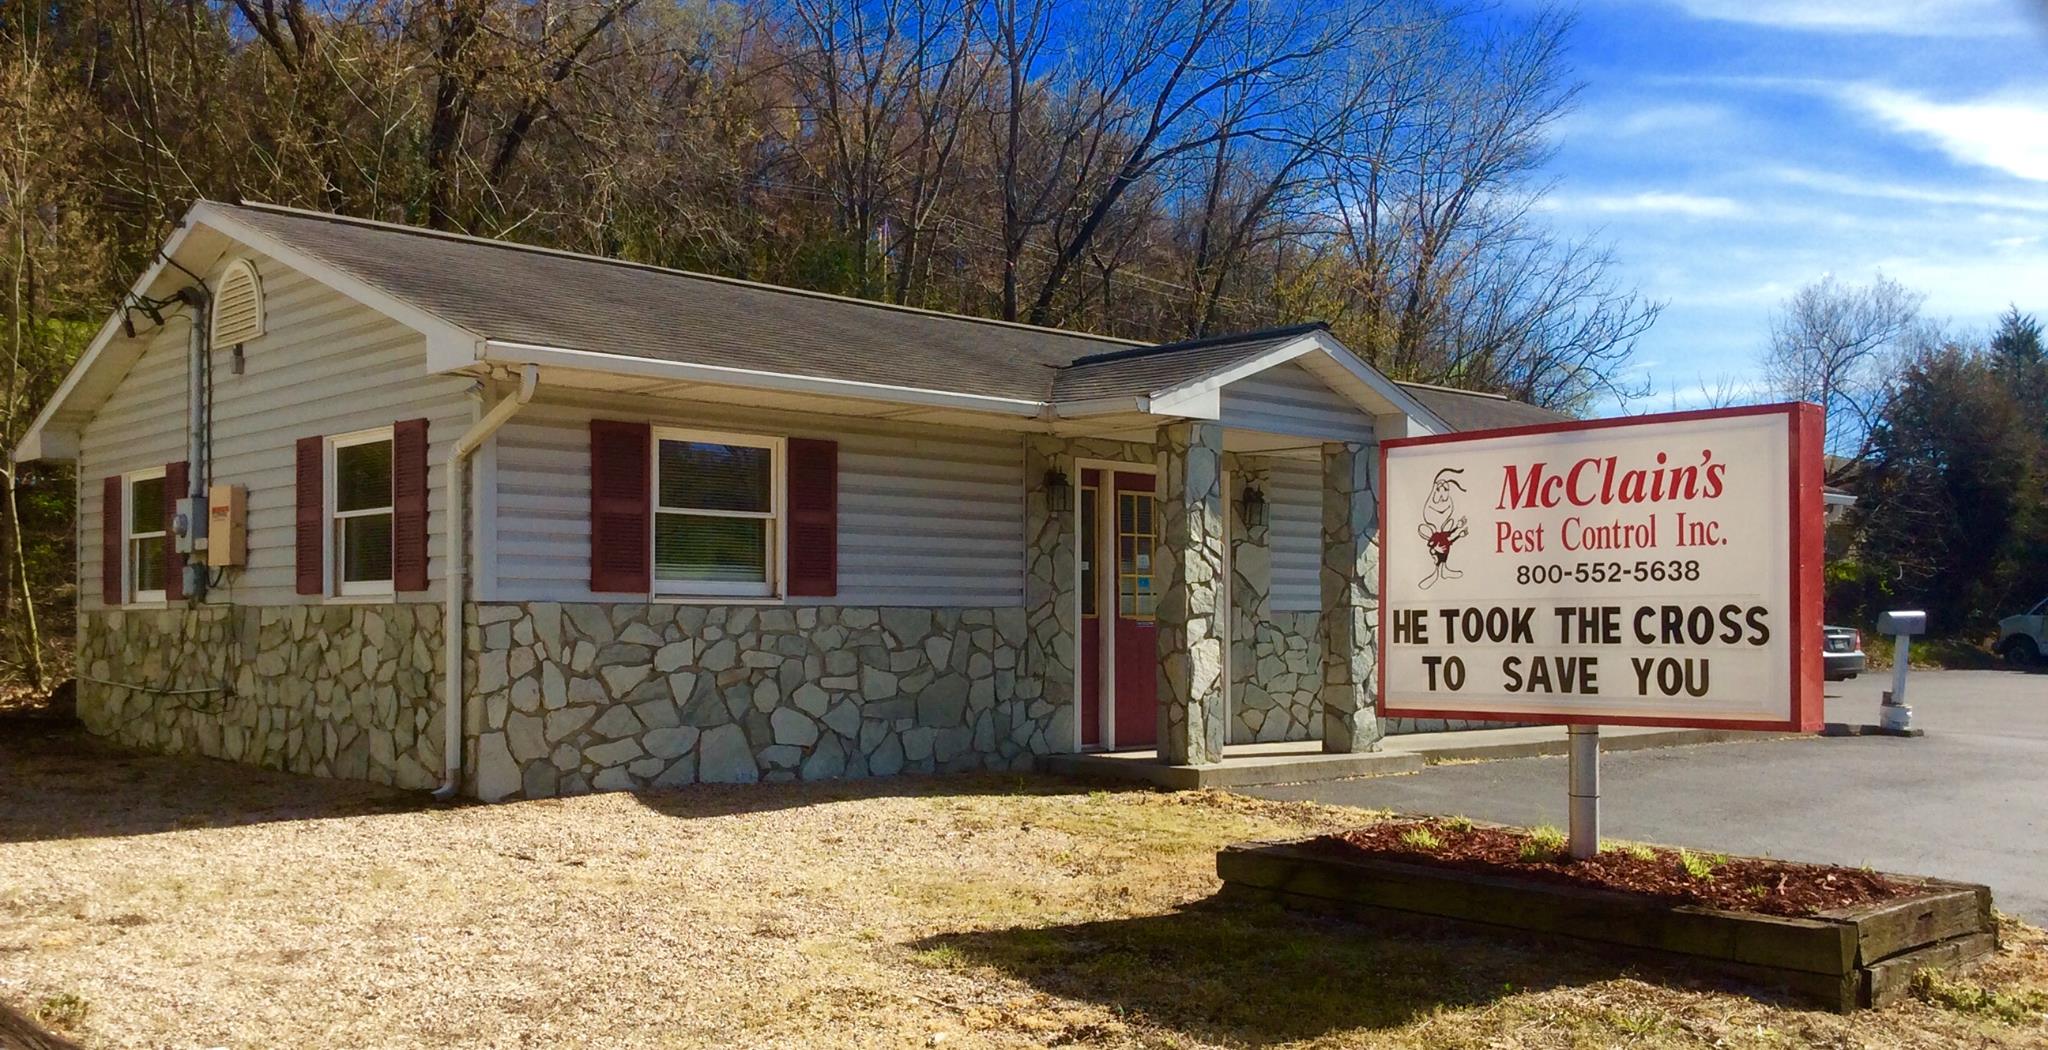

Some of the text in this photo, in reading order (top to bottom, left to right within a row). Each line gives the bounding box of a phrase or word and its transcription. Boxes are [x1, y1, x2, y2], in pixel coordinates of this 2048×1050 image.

[1495, 449, 1726, 510] McClain's
[1495, 512, 1727, 553] Pest Control Inc.
[1517, 560, 1700, 584] 800-552-5638
[1393, 605, 1770, 646] HE TOOK THE CROSS
[1422, 655, 1710, 697] TO SAVE YOU
